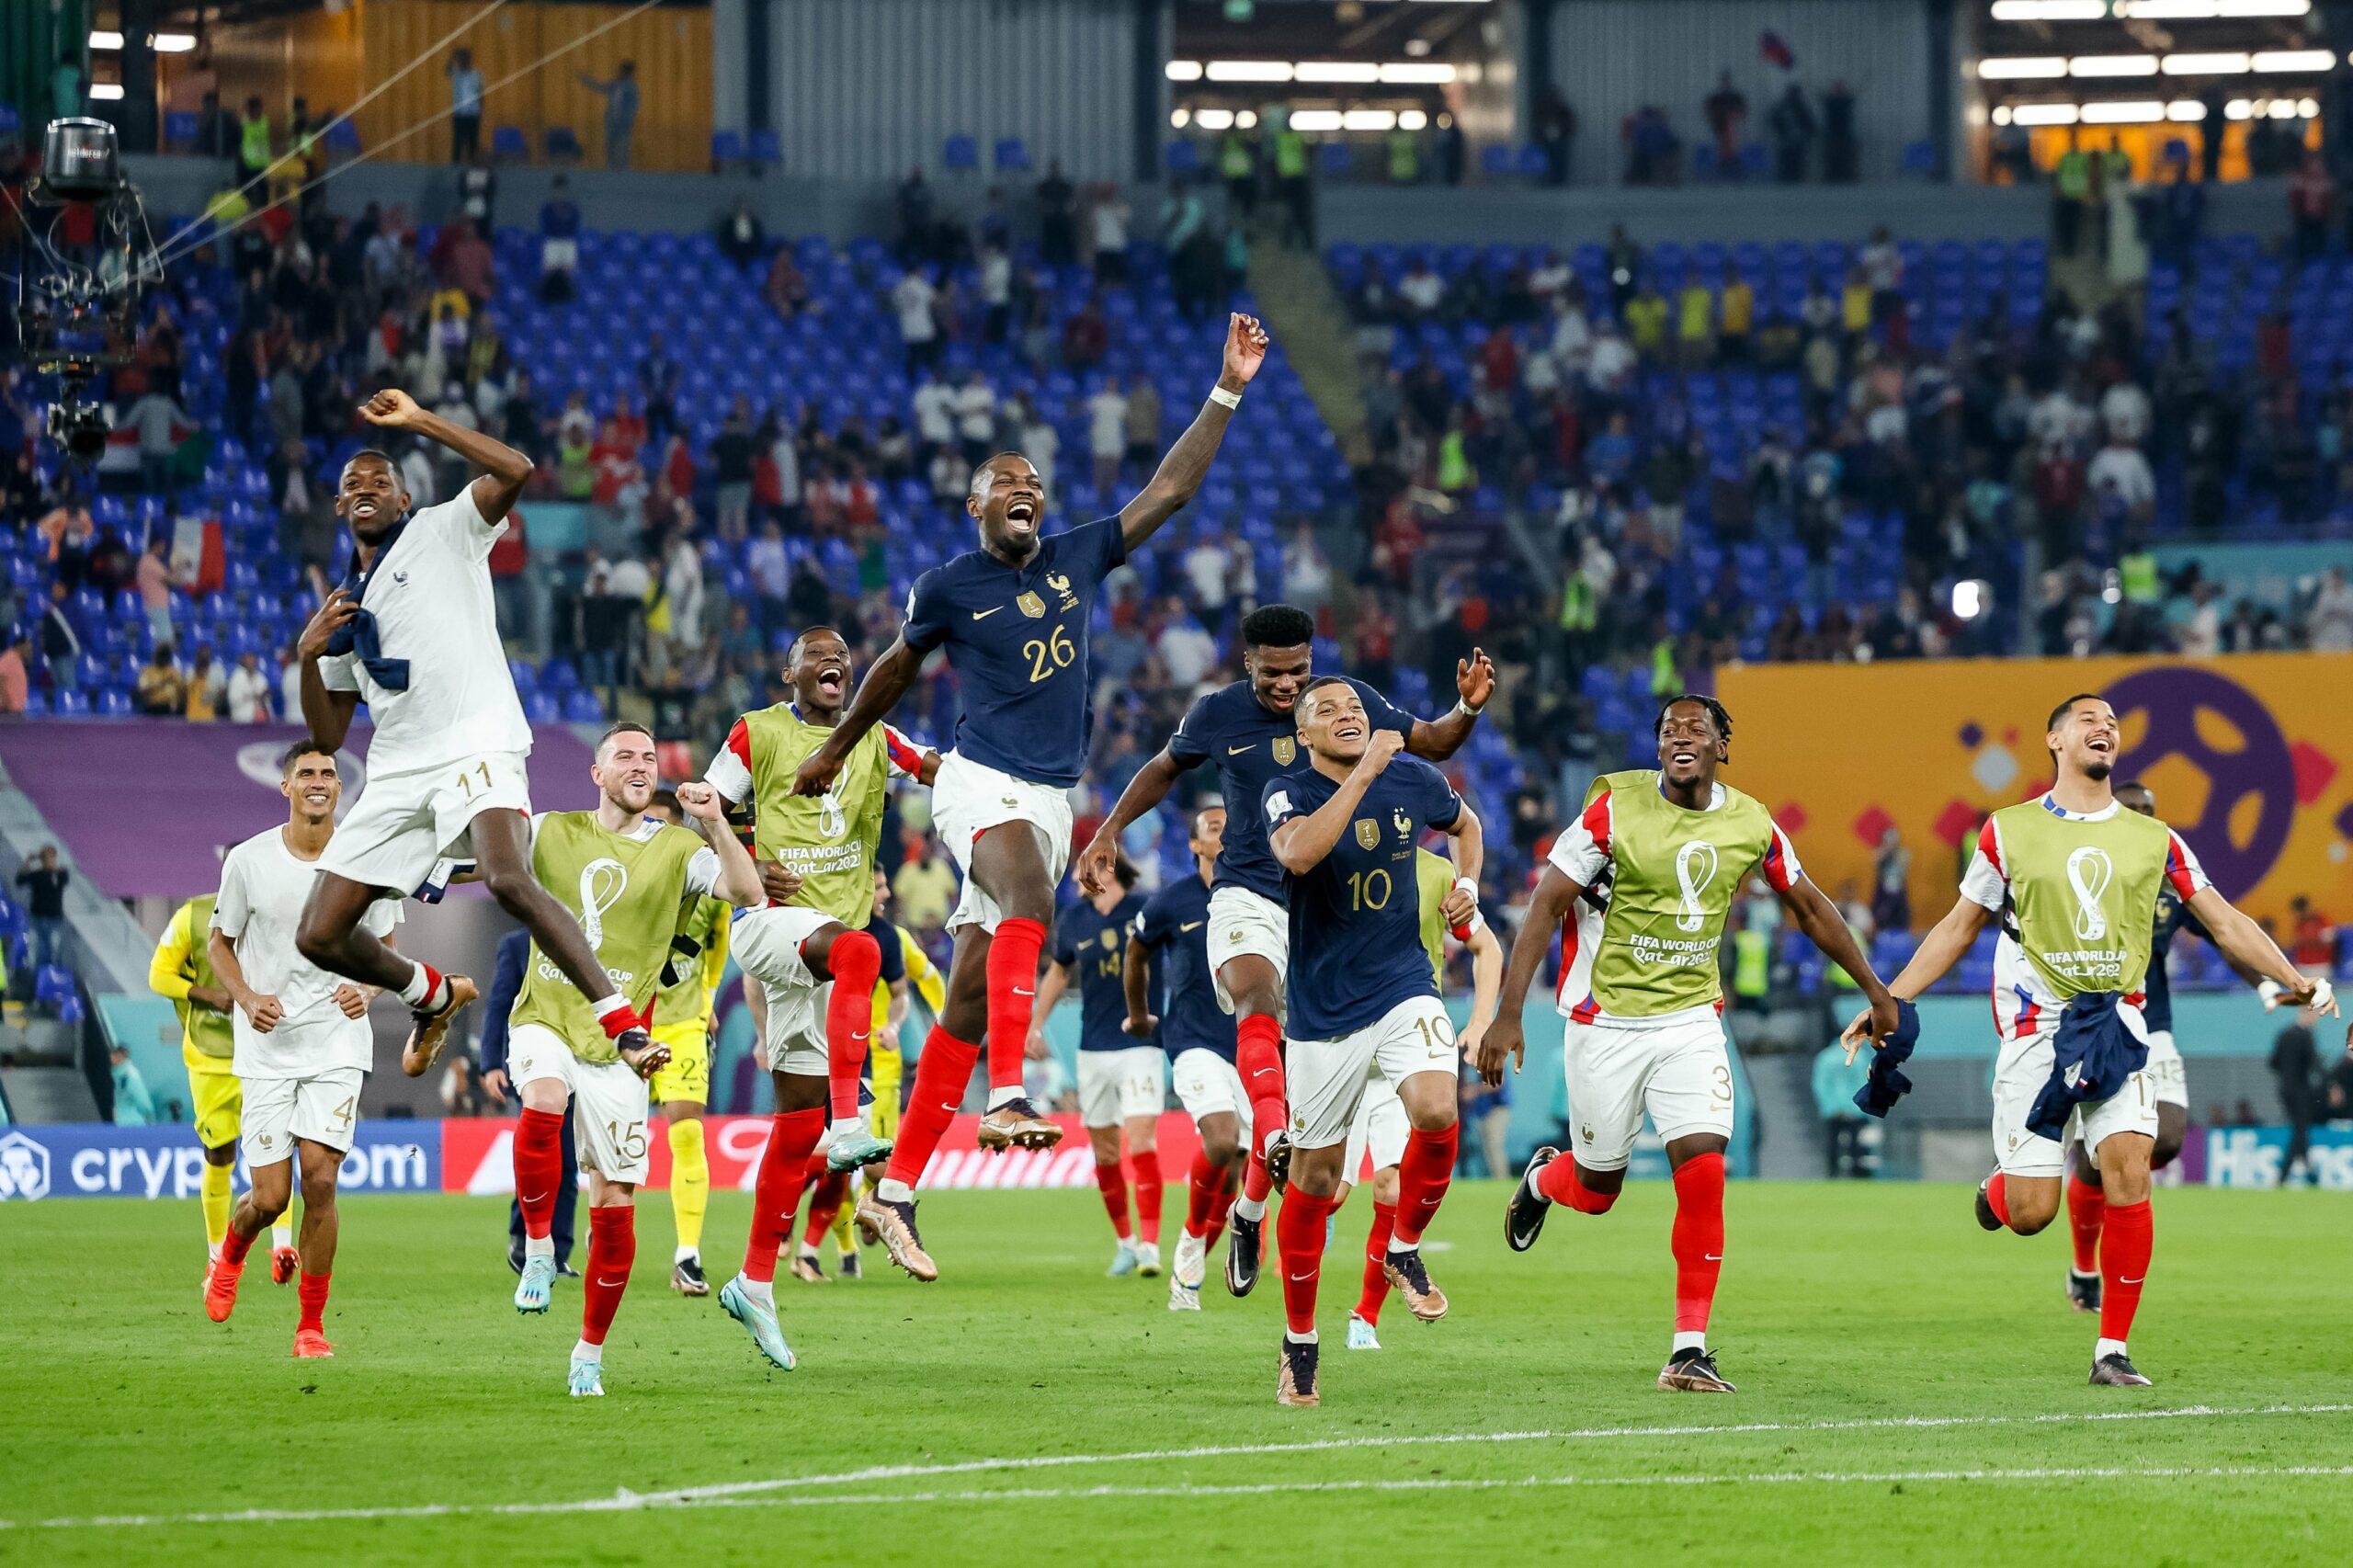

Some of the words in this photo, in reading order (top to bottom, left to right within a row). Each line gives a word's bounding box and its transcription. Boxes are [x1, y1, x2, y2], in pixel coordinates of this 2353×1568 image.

[1023, 624, 1075, 683] 26
[456, 761, 493, 798] 11
[779, 847, 810, 860] FIFA
[811, 844, 851, 859] WORLD
[1347, 868, 1392, 912] 10
[1630, 934, 1660, 950] FIFA
[1661, 938, 1707, 952] WORLD
[2042, 951, 2073, 963] FIFA
[607, 968, 634, 983] CUP
[1098, 951, 1120, 978] 14
[1413, 1016, 1456, 1048] 10
[1711, 1065, 1732, 1101] 3
[333, 1095, 354, 1129] 4
[607, 1120, 646, 1159] 15
[71, 1143, 426, 1199] crypom
